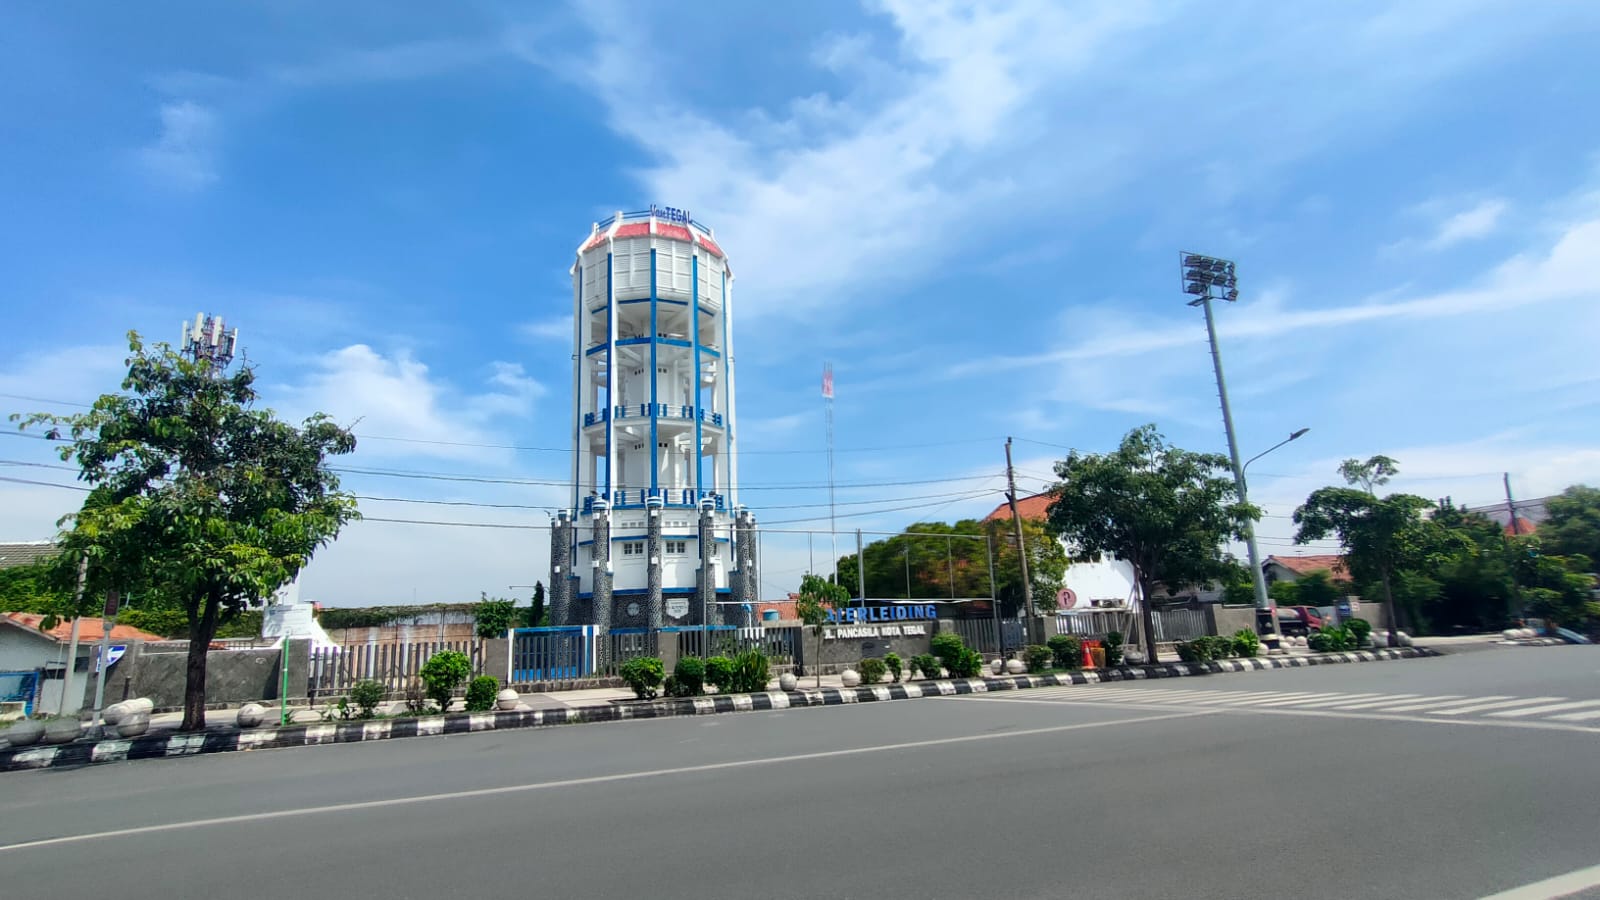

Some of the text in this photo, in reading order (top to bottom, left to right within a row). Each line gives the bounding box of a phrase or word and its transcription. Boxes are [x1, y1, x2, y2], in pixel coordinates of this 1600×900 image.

[665, 206, 692, 224] TEGAL
[825, 604, 937, 623] ATERLEIDING
[837, 626, 879, 639] PANCASILA
[902, 624, 926, 635] TEGAL
